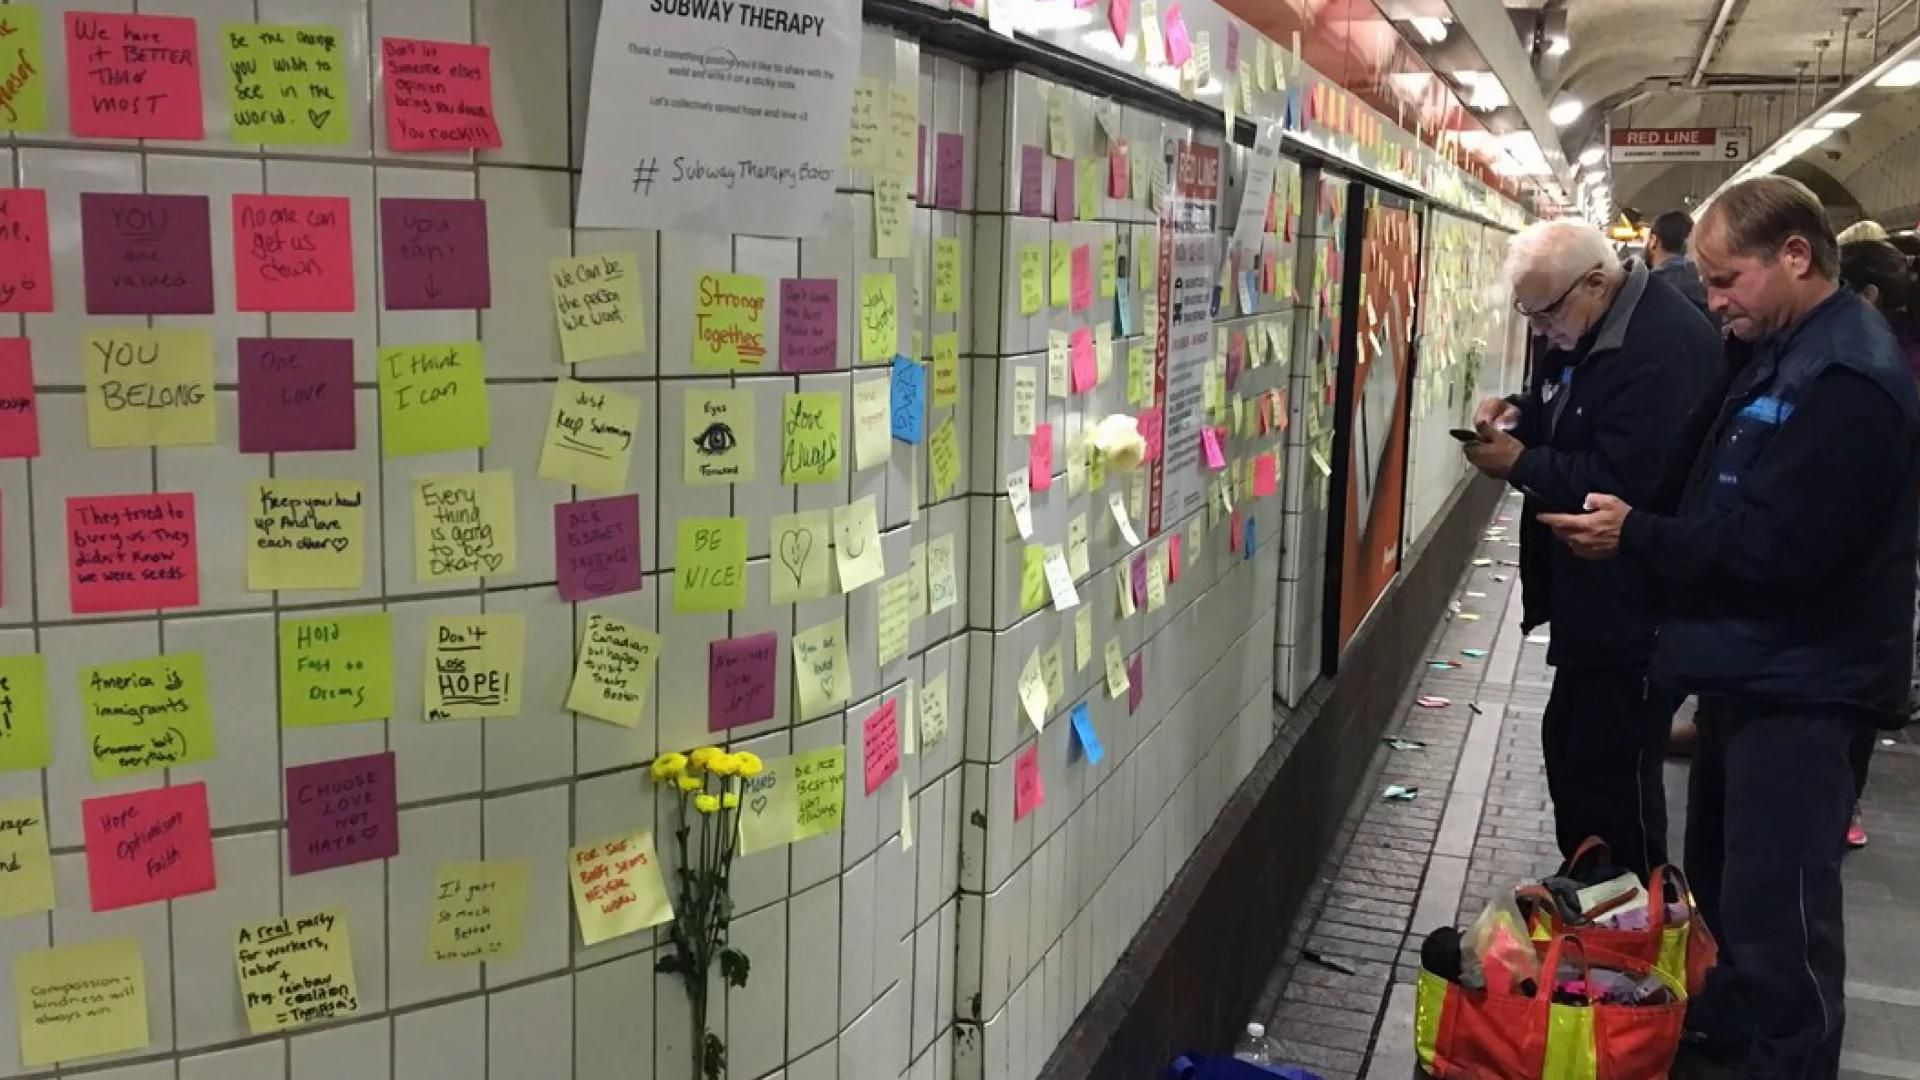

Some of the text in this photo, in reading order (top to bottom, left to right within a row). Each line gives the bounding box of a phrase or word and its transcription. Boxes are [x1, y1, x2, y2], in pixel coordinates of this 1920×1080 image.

[74, 18, 162, 43] We have
[739, 4, 825, 37] THERAPY
[124, 45, 193, 66] BETTER
[316, 59, 332, 72] to
[628, 43, 652, 57] Think
[653, 46, 663, 57] of
[663, 49, 705, 66] something
[757, 60, 772, 72] like
[773, 62, 783, 73] to
[784, 63, 806, 76] share
[806, 67, 822, 78] with
[823, 69, 835, 80] the
[668, 66, 690, 77] world
[691, 68, 705, 79] and
[706, 70, 725, 82] write
[734, 74, 744, 83] on
[752, 75, 775, 89] sticky
[281, 86, 298, 99] in
[650, 96, 797, 120] Let's collectively spread hope and love
[1626, 130, 1701, 144] RED LINE
[1725, 141, 1739, 160] 5
[1180, 152, 1217, 188] RED LINE
[113, 207, 170, 230] YOU
[306, 209, 336, 227] can
[402, 216, 451, 244] you
[290, 233, 317, 252] us
[126, 250, 163, 263] are
[602, 256, 622, 275] be
[91, 340, 159, 374] YOU
[387, 347, 462, 380] I think
[101, 380, 206, 412] BELONG
[395, 381, 459, 412] I can
[703, 400, 728, 417] Eyes
[785, 399, 824, 436] Love
[421, 483, 477, 509] Every
[77, 501, 184, 527] They tried to
[433, 505, 481, 529] thing
[253, 517, 276, 537] up
[430, 524, 494, 549] is going
[257, 536, 293, 550] each
[428, 540, 485, 558] to be
[694, 528, 722, 552] BE
[103, 568, 137, 583] were
[684, 563, 744, 591] NICE!
[438, 625, 488, 643] Don't
[90, 671, 155, 691] America
[438, 671, 510, 702] HOPE!
[93, 697, 190, 726] immigrants
[298, 770, 378, 805] CHOOSE
[322, 791, 376, 817] LOVE
[100, 805, 141, 833] Hope
[335, 812, 369, 830] NOT
[116, 811, 184, 861] Optimism
[145, 848, 182, 879] Faith
[238, 913, 336, 944] A real party
[238, 947, 261, 964] for
[242, 960, 282, 981] labor
[31, 976, 121, 997] Compassion
[35, 1009, 82, 1026] always
